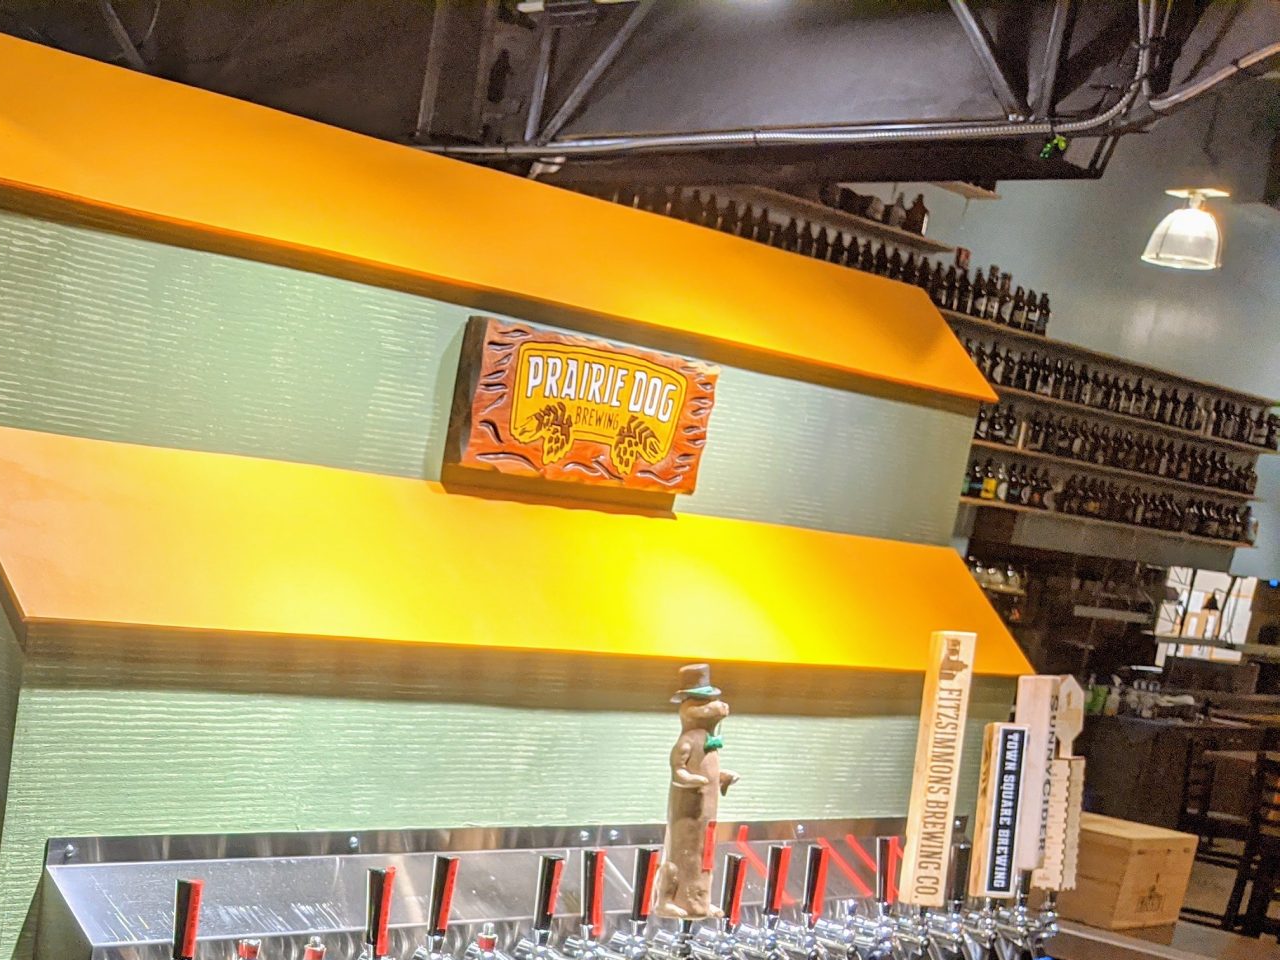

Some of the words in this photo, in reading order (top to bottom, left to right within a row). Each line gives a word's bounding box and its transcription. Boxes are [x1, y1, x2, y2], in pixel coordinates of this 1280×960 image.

[525, 355, 629, 408] PRAIRIE
[628, 371, 679, 423] DOG
[574, 405, 620, 431] BREWING
[926, 687, 962, 798] FITZSIMMONS
[1004, 732, 1020, 771] TOWN
[998, 774, 1015, 824] SQUARE
[918, 799, 949, 872] BREWING
[993, 829, 1010, 889] BREWING
[914, 872, 939, 900] CO.
